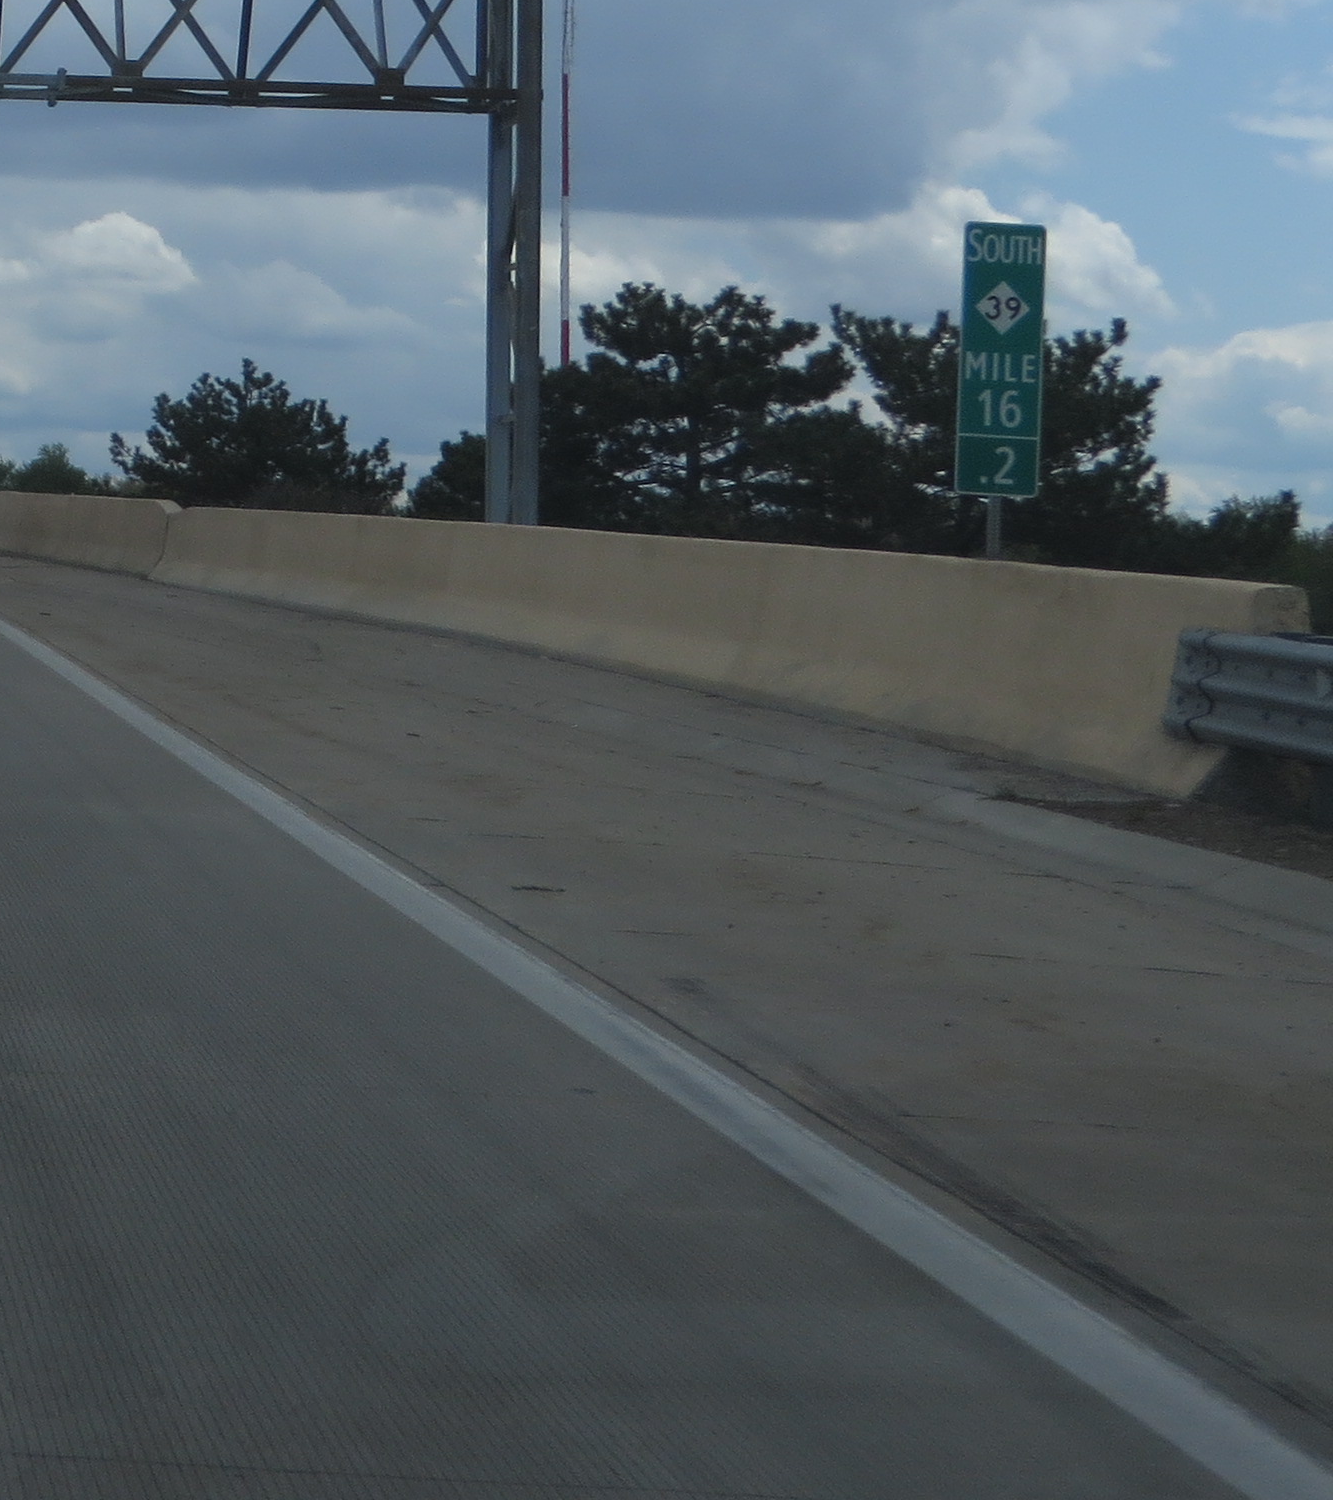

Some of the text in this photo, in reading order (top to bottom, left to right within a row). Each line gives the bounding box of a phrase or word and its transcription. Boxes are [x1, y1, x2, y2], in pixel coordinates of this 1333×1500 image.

[967, 228, 1043, 265] SOUTH
[984, 295, 1022, 321] 39
[965, 351, 1036, 383] MILE
[978, 390, 1021, 427] 16
[980, 446, 1015, 484] .2
